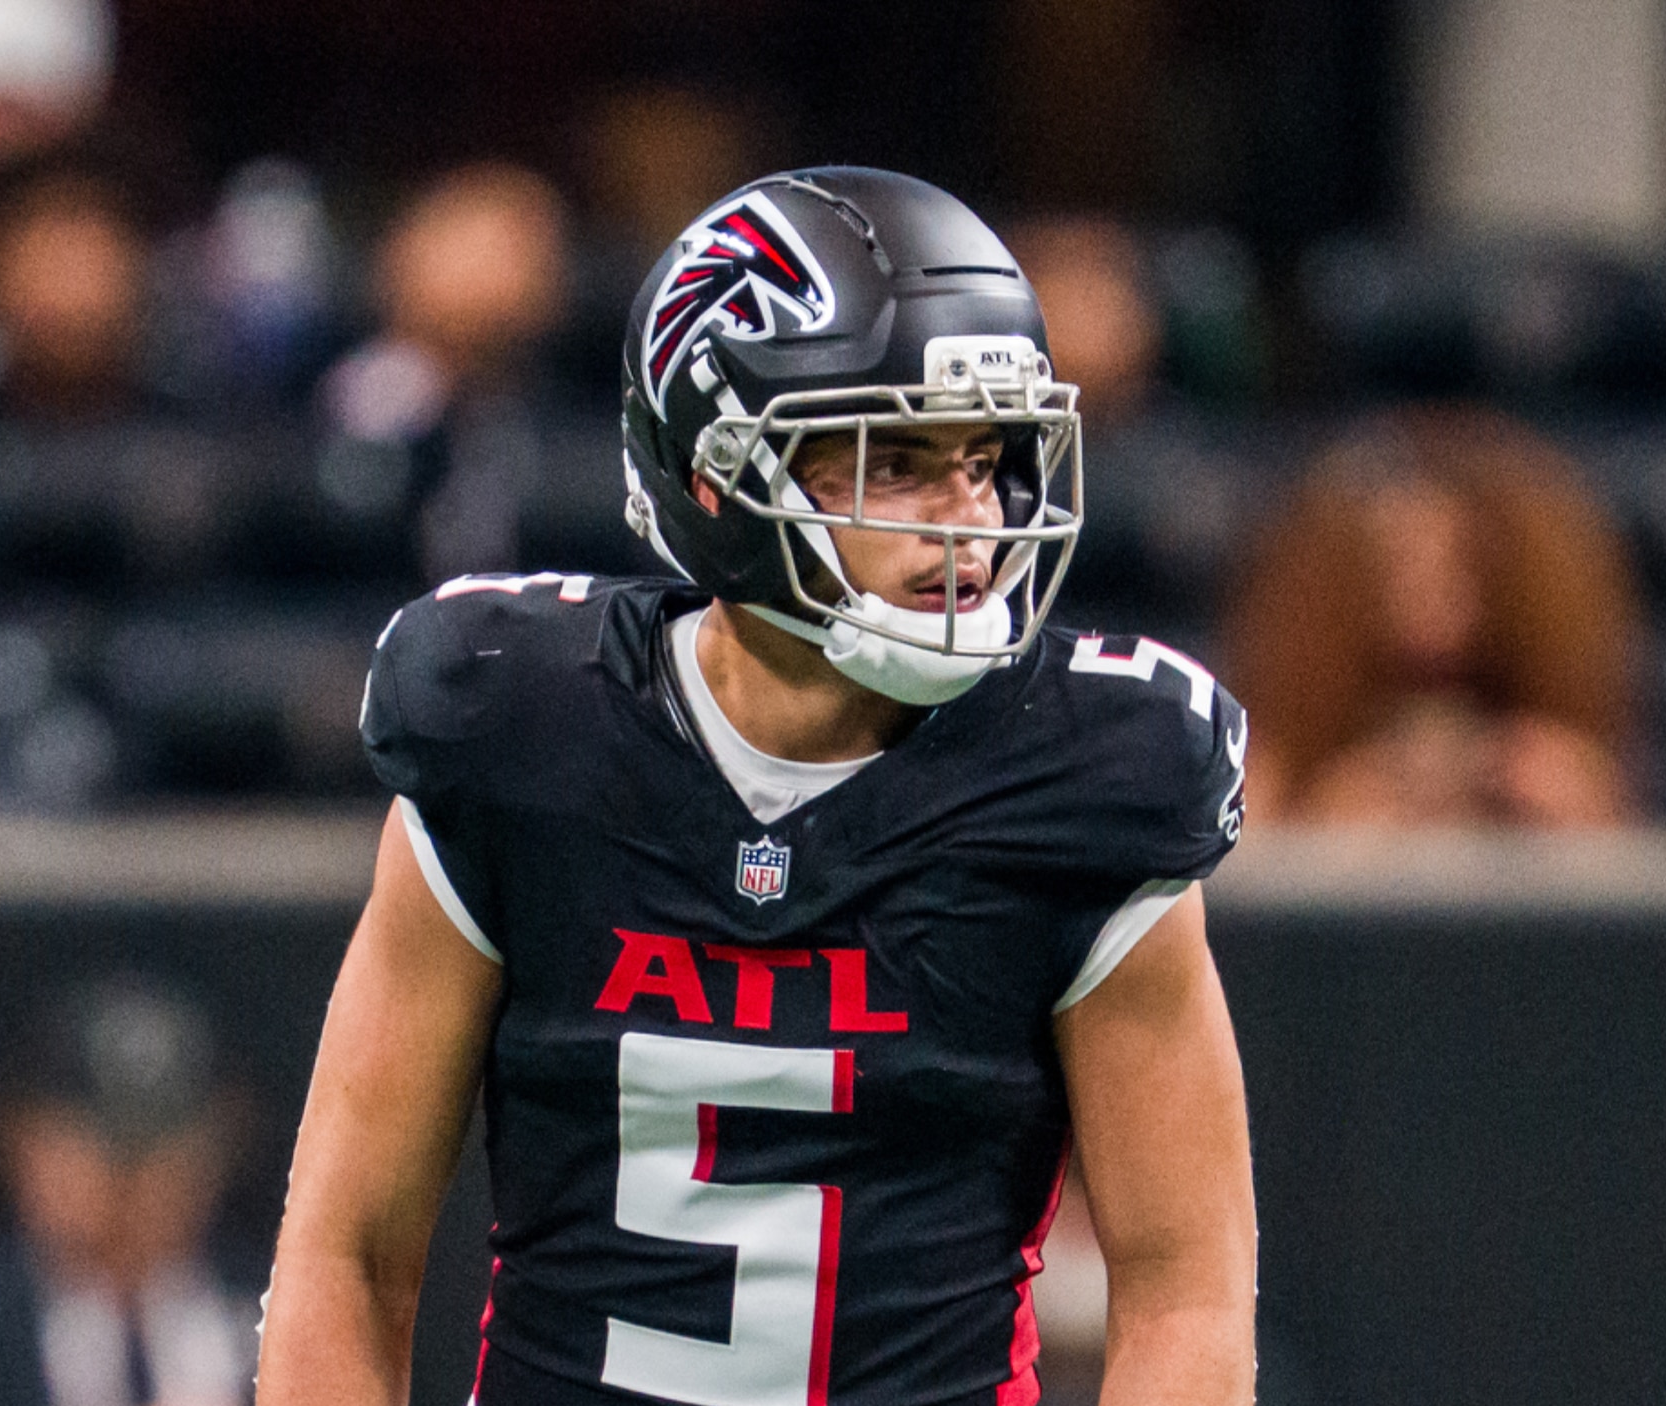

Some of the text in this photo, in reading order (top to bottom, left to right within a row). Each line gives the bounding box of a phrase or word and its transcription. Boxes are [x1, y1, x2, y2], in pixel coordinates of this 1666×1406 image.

[980, 351, 1016, 365] ATL
[1068, 635, 1216, 722] 5
[744, 866, 780, 893] NFL
[593, 927, 909, 1033] ATL
